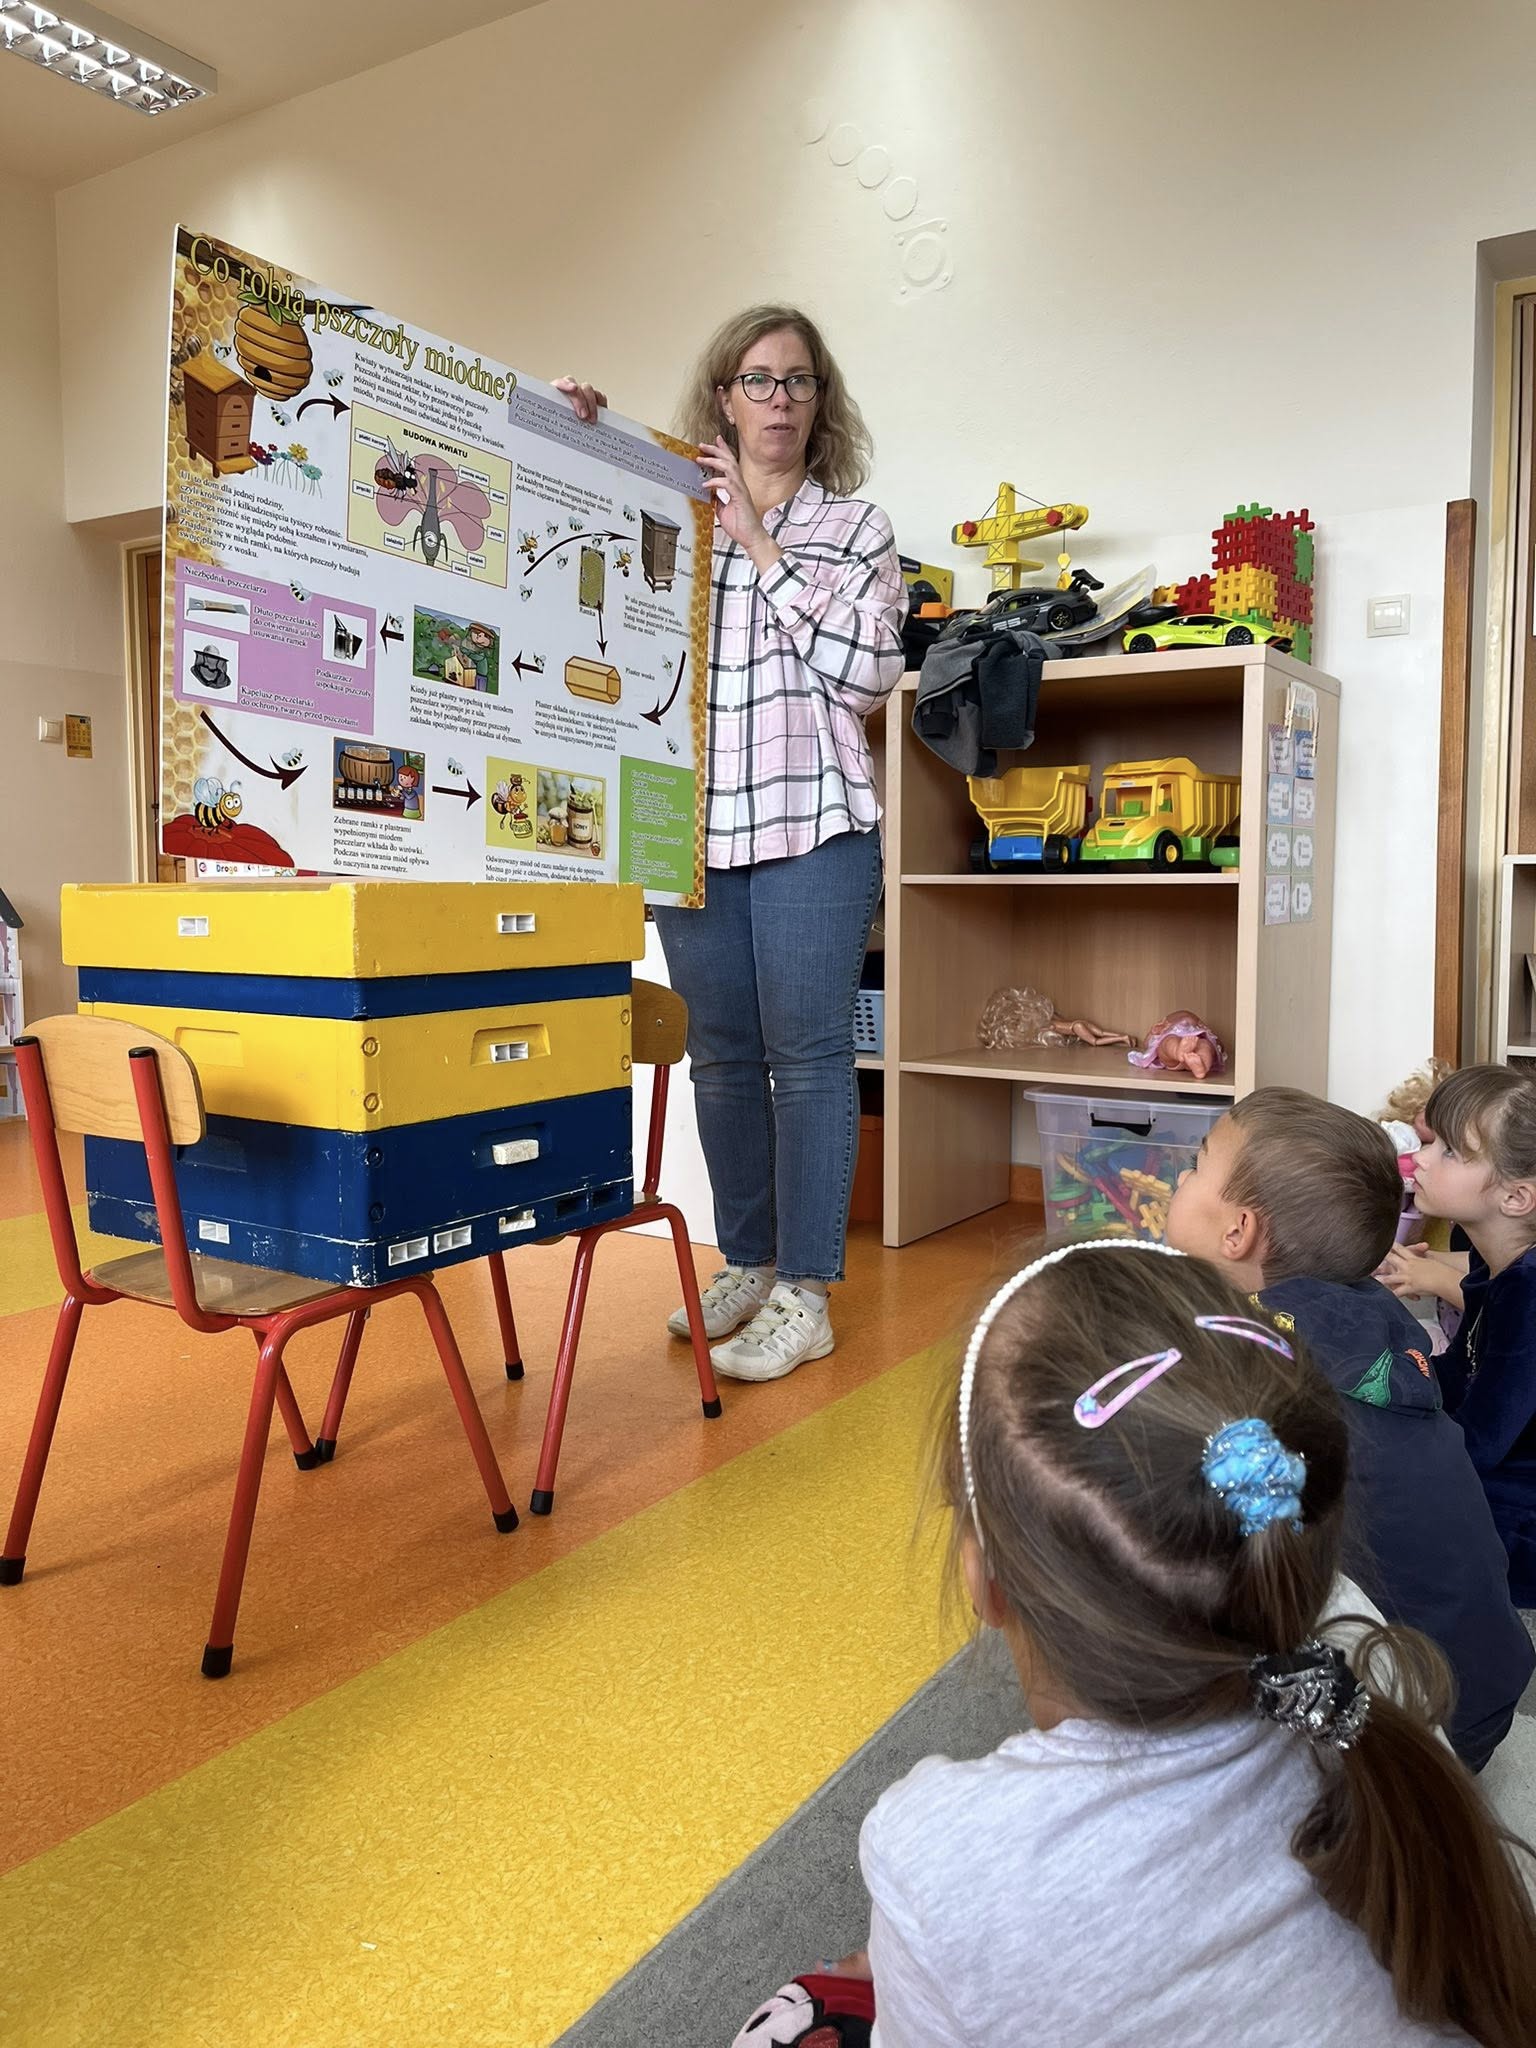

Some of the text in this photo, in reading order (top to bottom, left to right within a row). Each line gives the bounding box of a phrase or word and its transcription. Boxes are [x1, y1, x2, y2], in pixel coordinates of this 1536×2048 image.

[190, 237, 517, 405] Co robią pszczoły miodne?
[404, 428, 437, 447] BUDOWA
[439, 442, 467, 458] KWIATU
[180, 486, 198, 496] czyli
[233, 498, 236, 506] i
[238, 500, 289, 522] kilkudziesięciu
[291, 517, 313, 531] tysięcy
[194, 476, 201, 484] to
[203, 479, 219, 489] dom
[221, 484, 232, 494] dla
[234, 488, 255, 502] jednej
[257, 496, 284, 511] rodziny,
[180, 507, 190, 515] ale
[193, 511, 204, 520] ich
[206, 517, 233, 528] wnętrze
[235, 524, 264, 537] wygląda
[180, 494, 193, 504] Ule
[241, 512, 250, 524] się
[253, 518, 277, 531] między
[296, 529, 326, 544] kształtem
[328, 538, 330, 546] i
[332, 541, 368, 558] wymiarami,
[180, 530, 200, 541] swoje
[200, 536, 226, 550] plastry
[180, 517, 211, 535] Znajdują
[214, 529, 223, 539] się
[234, 534, 248, 544] nich
[251, 540, 272, 552] ramki,
[284, 547, 308, 561] których
[310, 556, 337, 570] pszczoły
[334, 816, 358, 826] Zebrane
[361, 821, 377, 829] ramki
[385, 823, 411, 833] plastrami
[334, 828, 402, 842] wypełnionymi miodem
[334, 839, 365, 848] pszczelarz
[367, 841, 388, 850] wkłada
[390, 843, 397, 852] do
[334, 848, 429, 866] Podczas wirowania miód spływa
[334, 858, 341, 866] do
[343, 861, 370, 869] naczynia
